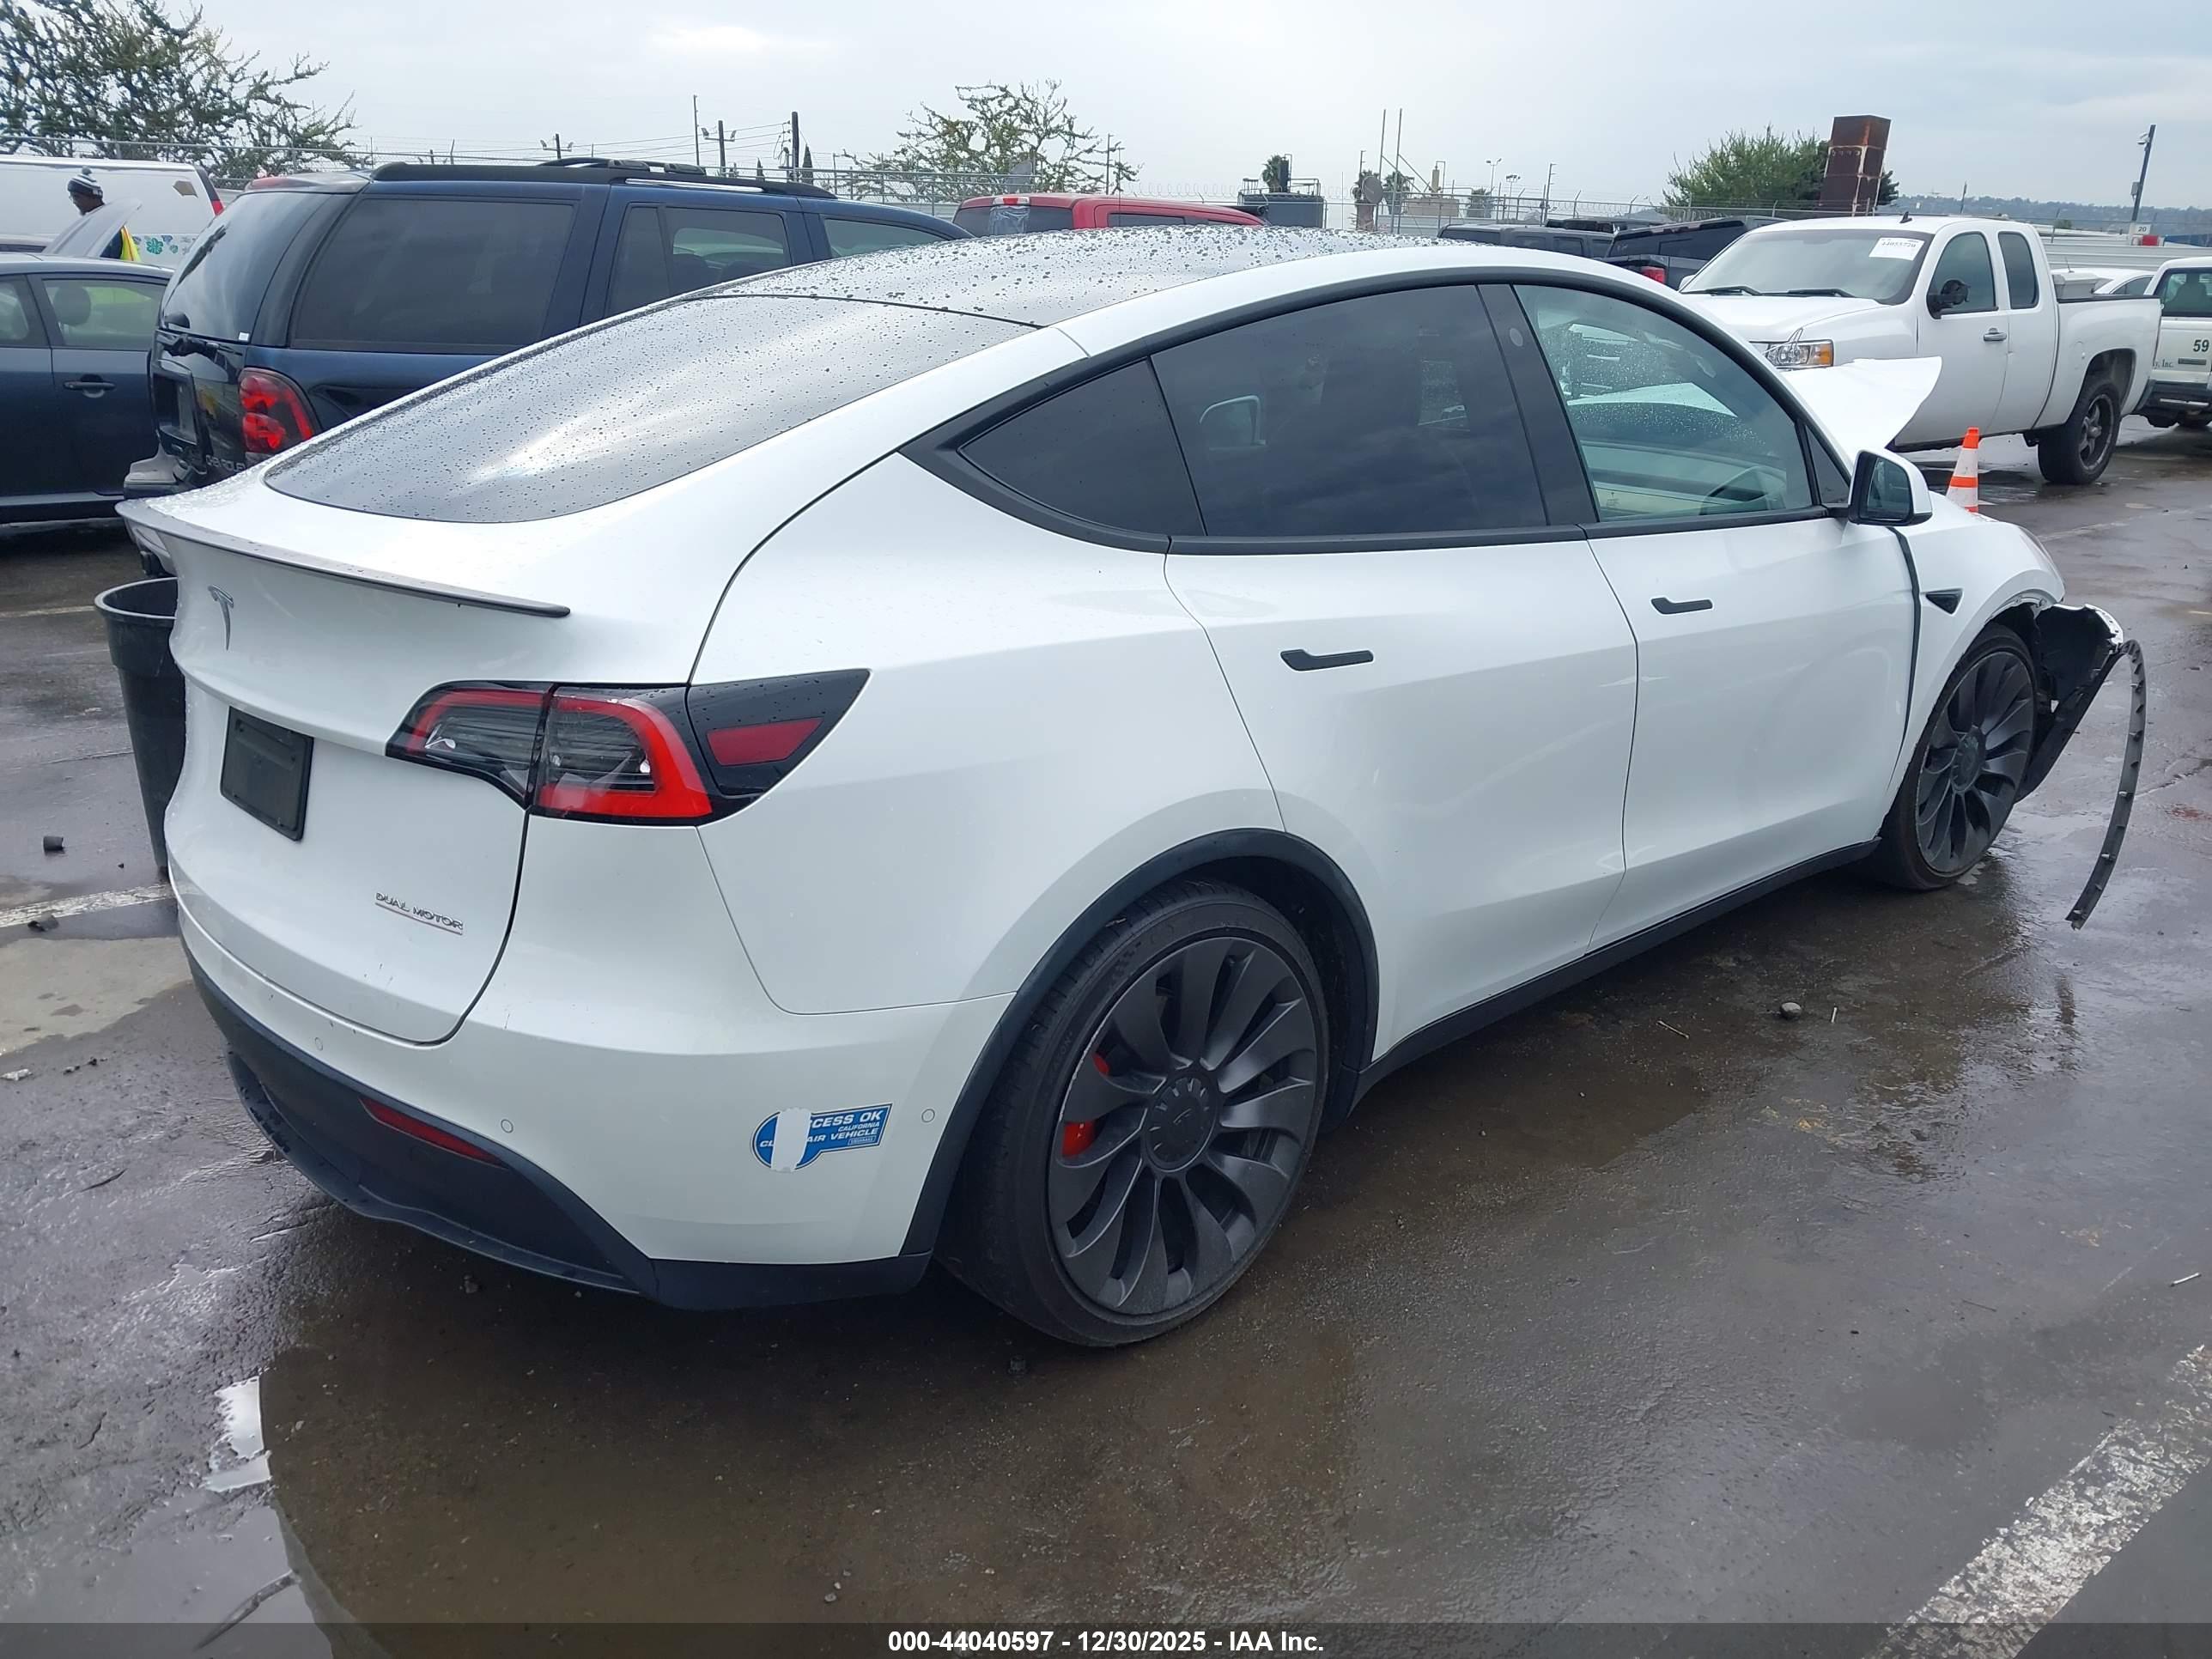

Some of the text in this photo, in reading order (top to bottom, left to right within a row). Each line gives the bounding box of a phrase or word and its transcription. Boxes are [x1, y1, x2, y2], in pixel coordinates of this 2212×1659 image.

[2192, 339, 2210, 353] 59
[2161, 358, 2174, 368] Inc.
[375, 890, 464, 931] DUAL MOTOR
[810, 1109, 884, 1129] CESS OK
[837, 1121, 880, 1133] CALIFORNIA
[806, 1127, 879, 1143] AIR VEHICLE
